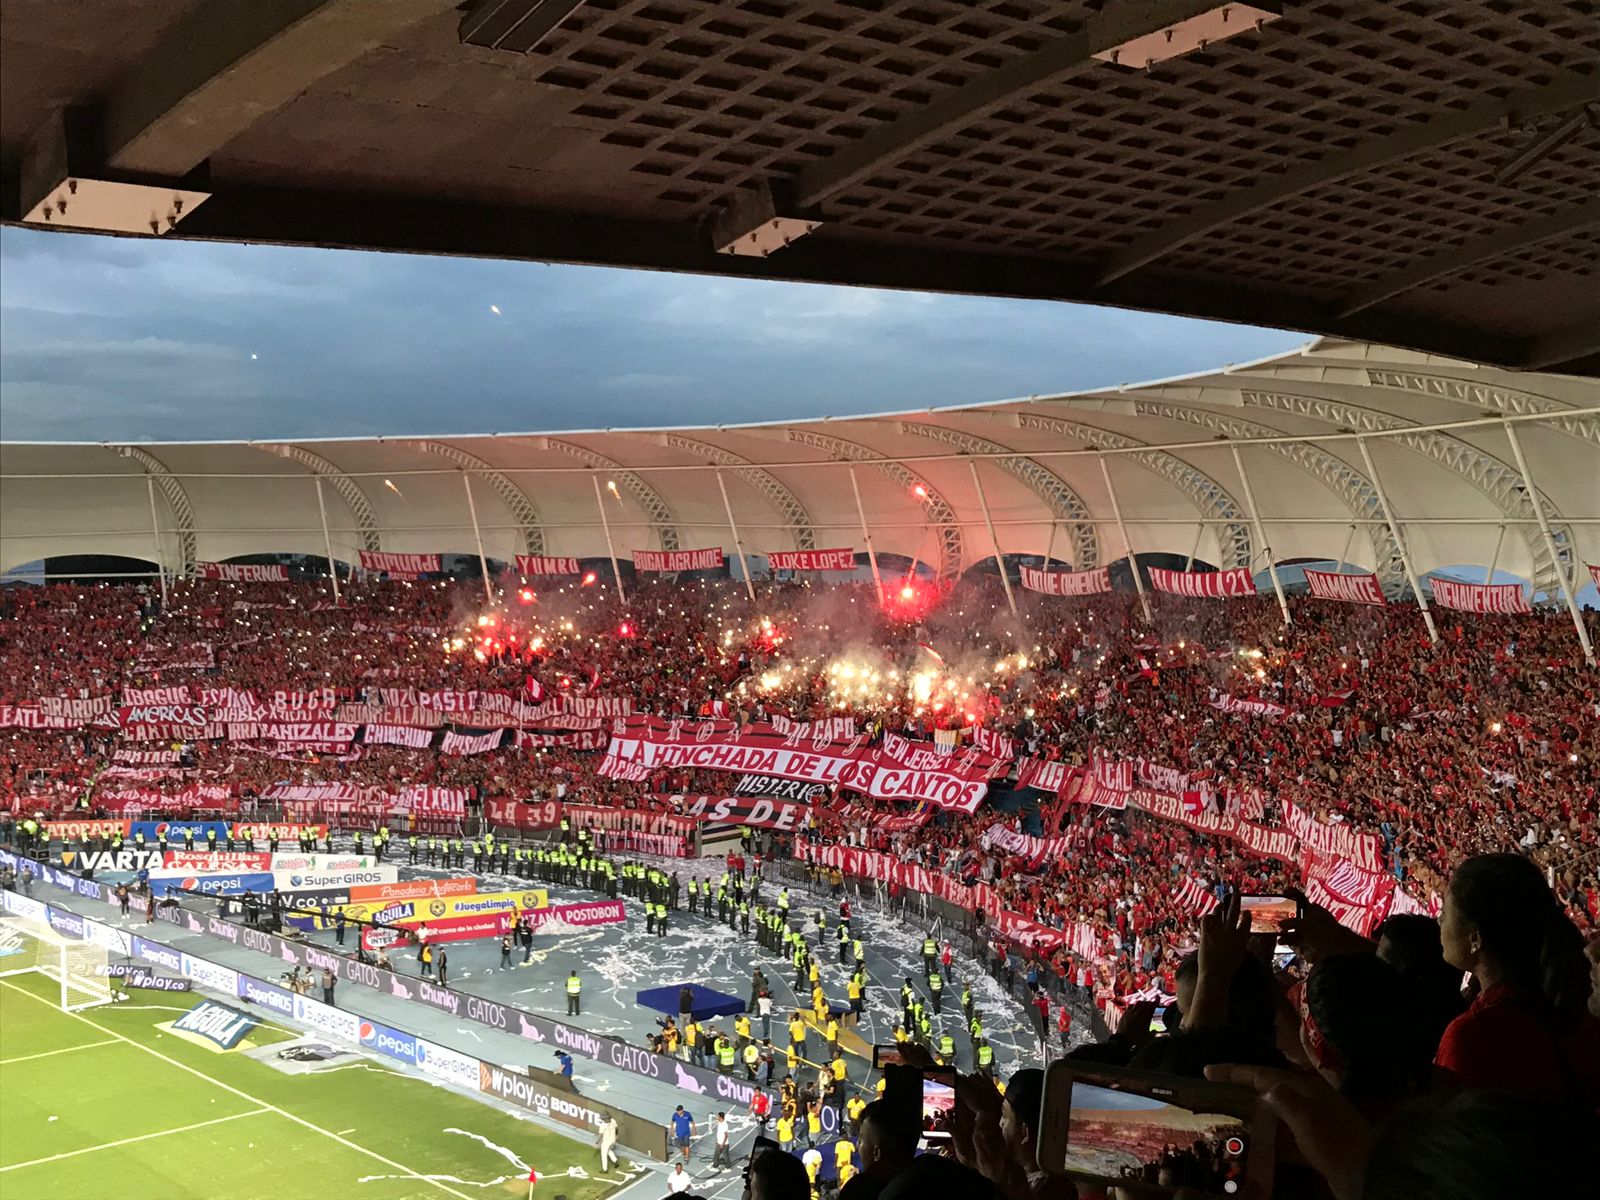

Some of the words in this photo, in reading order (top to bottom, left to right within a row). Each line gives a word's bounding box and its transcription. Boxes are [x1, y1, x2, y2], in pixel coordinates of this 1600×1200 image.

[218, 564, 289, 582] INFERNAL
[519, 556, 580, 575] YUMBO
[633, 551, 723, 571] BUGALAGRANDE
[768, 553, 808, 571] BLOKE
[812, 551, 855, 570] LOPEZ
[1226, 569, 1256, 595] 21
[1307, 572, 1381, 603] DIAMANTE
[1431, 579, 1532, 613] BUENAVENTURA
[40, 695, 112, 719] GIRARDOT
[274, 688, 336, 710] BUGA
[812, 717, 855, 740] CAPO
[883, 728, 910, 763] NEW
[616, 738, 645, 764] LA
[651, 744, 778, 771] HINCHADA
[784, 752, 822, 776] DE
[821, 757, 874, 787] LOS
[880, 770, 979, 807] CANTOS
[527, 800, 557, 827] 39
[744, 799, 796, 830] DE
[47, 822, 124, 837] ATORADE
[79, 850, 164, 871] VARTA
[202, 877, 241, 892] pepsi
[455, 899, 515, 913] #JuegaLimpio
[500, 911, 564, 930] MNZANA
[565, 905, 620, 923] POSTOBON
[133, 975, 185, 990] Wplay.co
[174, 1002, 249, 1044] AGUILA
[208, 918, 238, 943] Chunky
[243, 929, 272, 953] GATOS
[305, 949, 339, 975] Chunky
[346, 960, 380, 988] GATOS
[420, 983, 459, 1014] Chunky
[467, 997, 507, 1028] GATOS
[554, 1024, 600, 1059] Chunky
[611, 1042, 659, 1078] GATOS
[717, 1074, 773, 1116] Chuny
[378, 1033, 415, 1057] pepsi
[491, 1068, 549, 1109] Wplay.co
